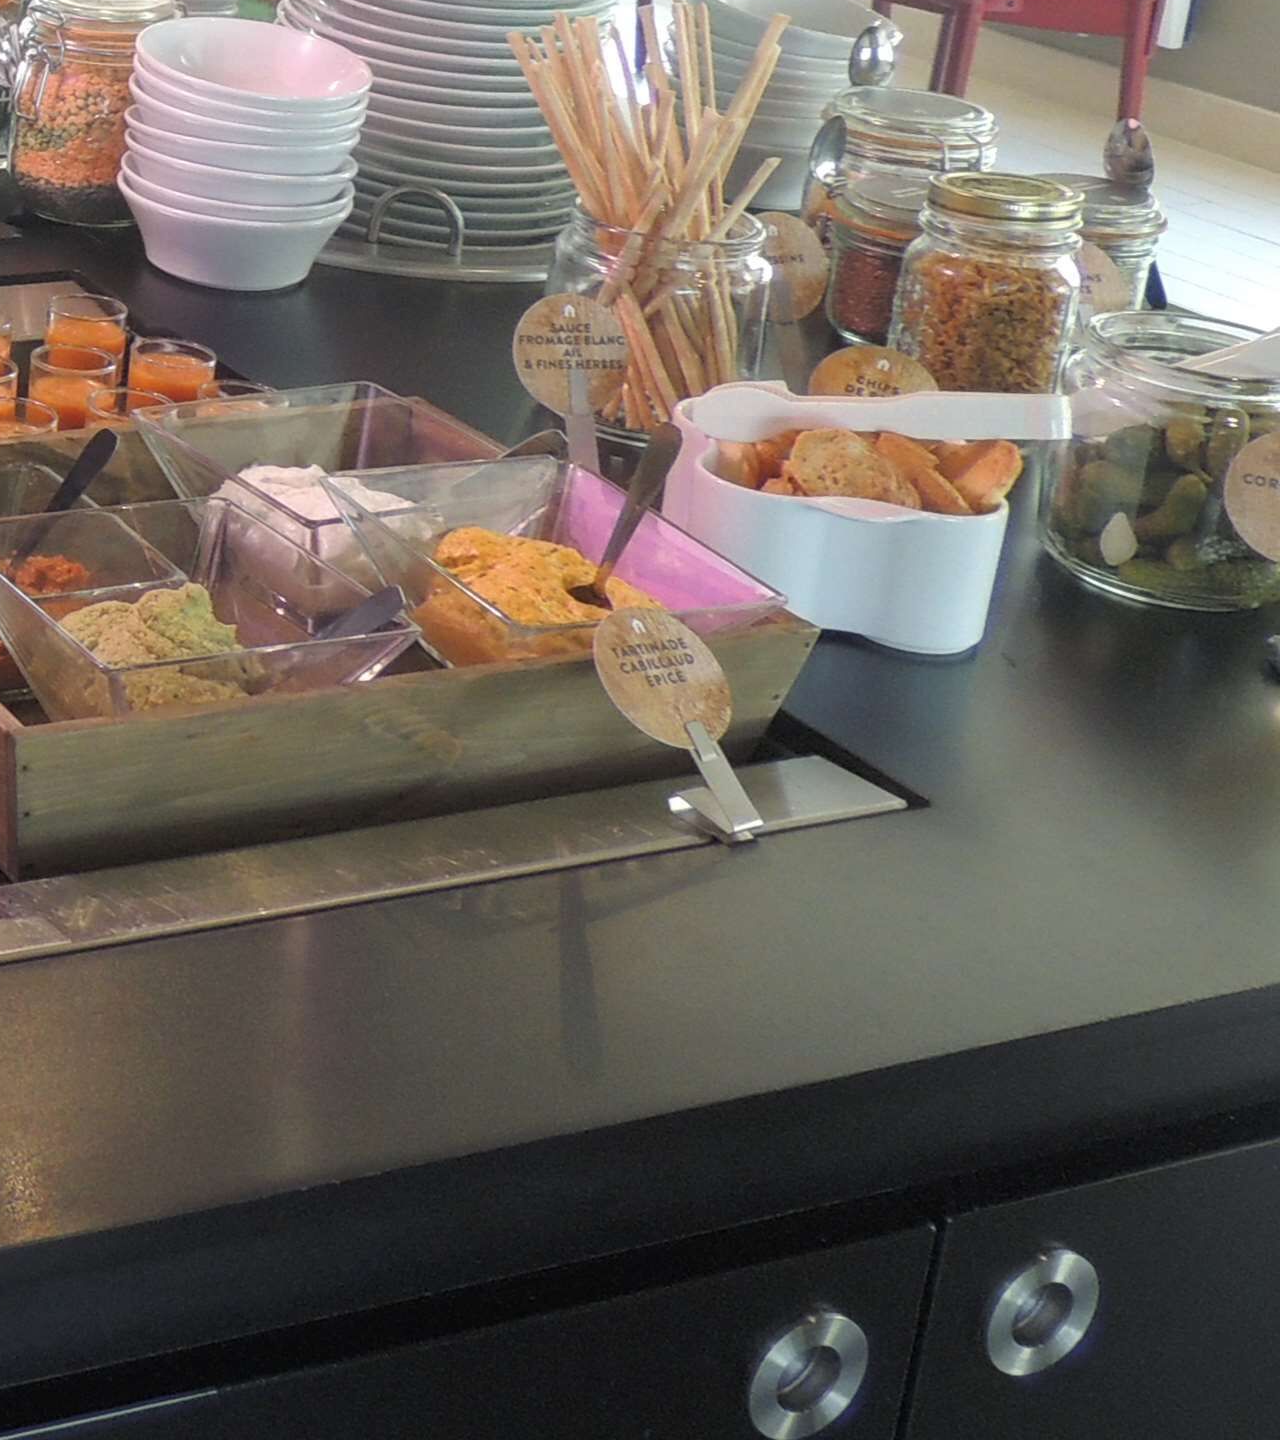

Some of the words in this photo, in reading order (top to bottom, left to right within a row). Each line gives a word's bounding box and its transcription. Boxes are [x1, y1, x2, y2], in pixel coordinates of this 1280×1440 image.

[549, 322, 592, 333] SAUCE
[519, 335, 581, 345] FROMAGE
[584, 335, 625, 346] BLANC
[536, 359, 573, 370] FINES
[575, 359, 625, 370] HERBES
[855, 375, 900, 396] CHIPS
[611, 636, 689, 659] TARTINADE
[619, 653, 695, 675] CABILLAUD
